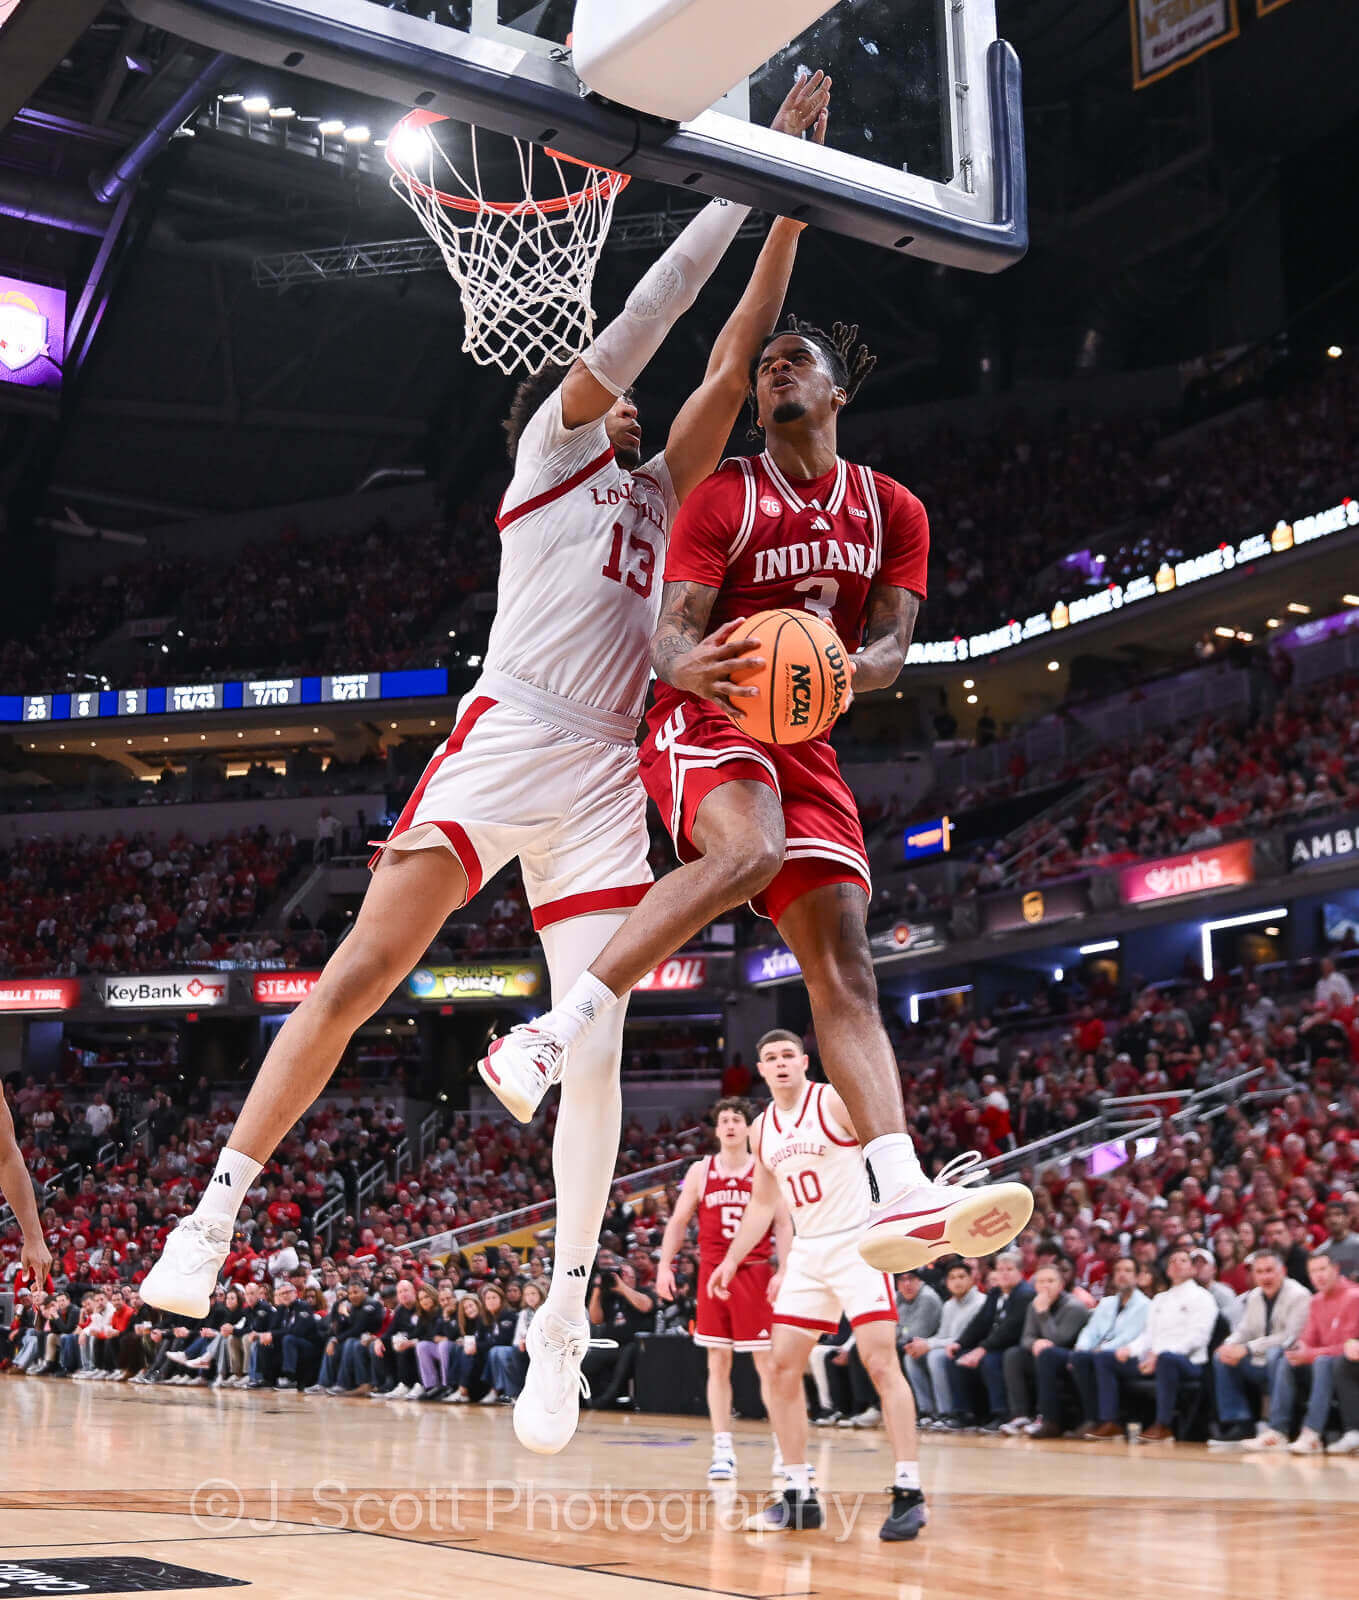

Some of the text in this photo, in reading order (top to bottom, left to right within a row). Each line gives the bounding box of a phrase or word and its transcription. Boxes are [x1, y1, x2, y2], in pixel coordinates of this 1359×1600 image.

[602, 521, 655, 599] 13
[794, 577, 839, 621] 3
[254, 688, 289, 705] 7/10
[790, 664, 811, 726] NCAA
[1291, 826, 1359, 863] AMB
[1173, 856, 1221, 890] mhs
[257, 979, 307, 996] STEAK
[661, 960, 704, 987] OIL
[107, 983, 182, 1002] KeyBank
[770, 1142, 826, 1167] OUISVILLE
[705, 1190, 751, 1208] INDIAN
[787, 1171, 822, 1207] 10
[721, 1206, 743, 1239] 5
